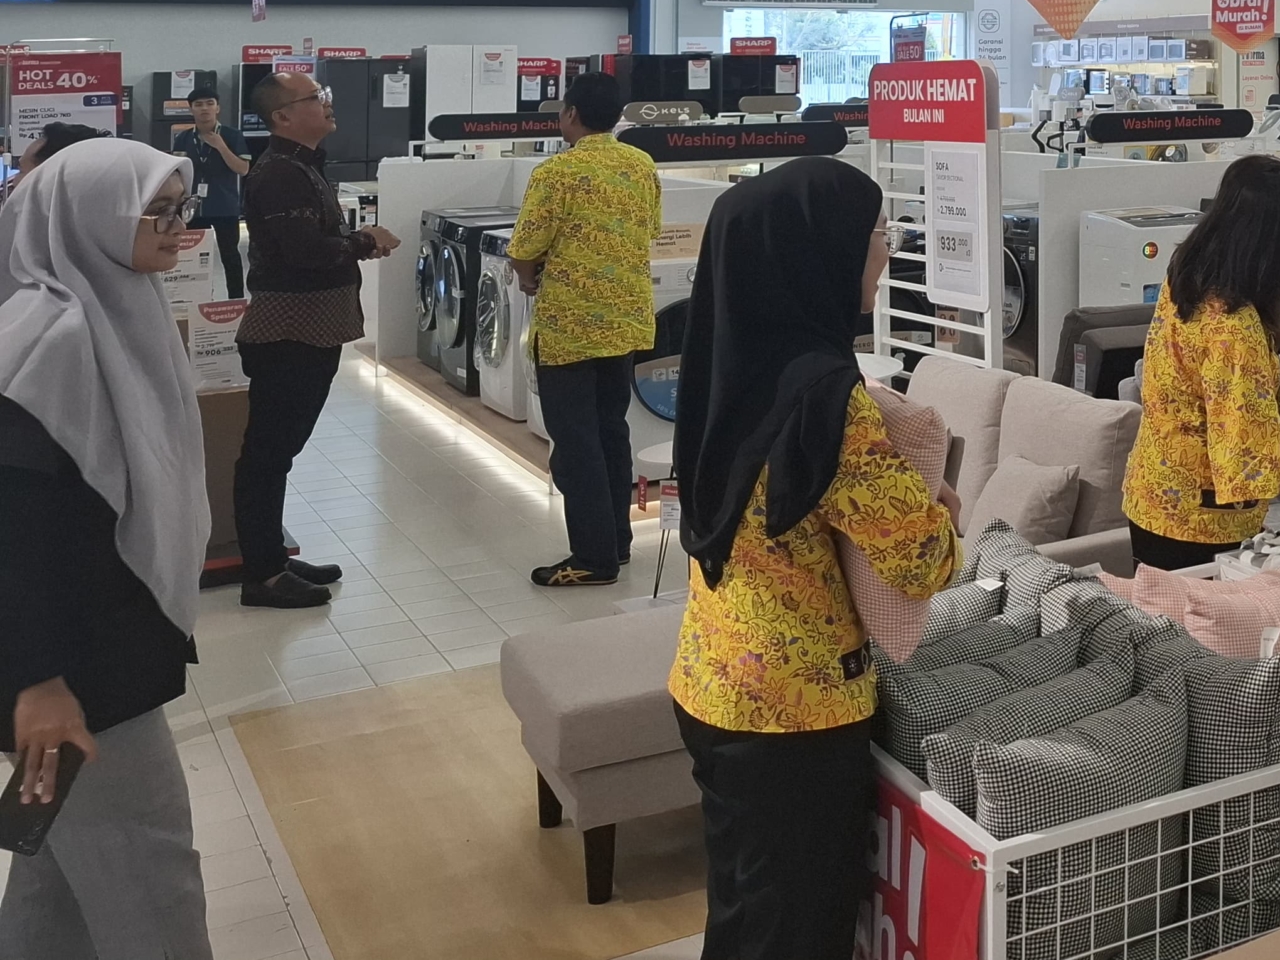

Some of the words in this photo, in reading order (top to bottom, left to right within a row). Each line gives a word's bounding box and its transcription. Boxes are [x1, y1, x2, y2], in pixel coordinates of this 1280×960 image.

[735, 39, 772, 47] SHARP
[18, 69, 54, 81] HOT
[18, 81, 54, 90] DEALS
[873, 79, 925, 102] PRODUK
[926, 78, 977, 102] HEMAT
[903, 108, 931, 123] BULAN
[932, 108, 945, 123] INI
[463, 120, 518, 133] Washing
[521, 119, 562, 131] Machi
[1122, 115, 1172, 131] Washing
[1174, 114, 1222, 127] Machine
[667, 132, 736, 148] Washing
[741, 131, 806, 145] Machine
[935, 161, 949, 171] SOFA
[940, 235, 957, 252] 933
[203, 303, 243, 314] Penawaran
[210, 311, 237, 321] Spesial
[205, 348, 222, 356] 906
